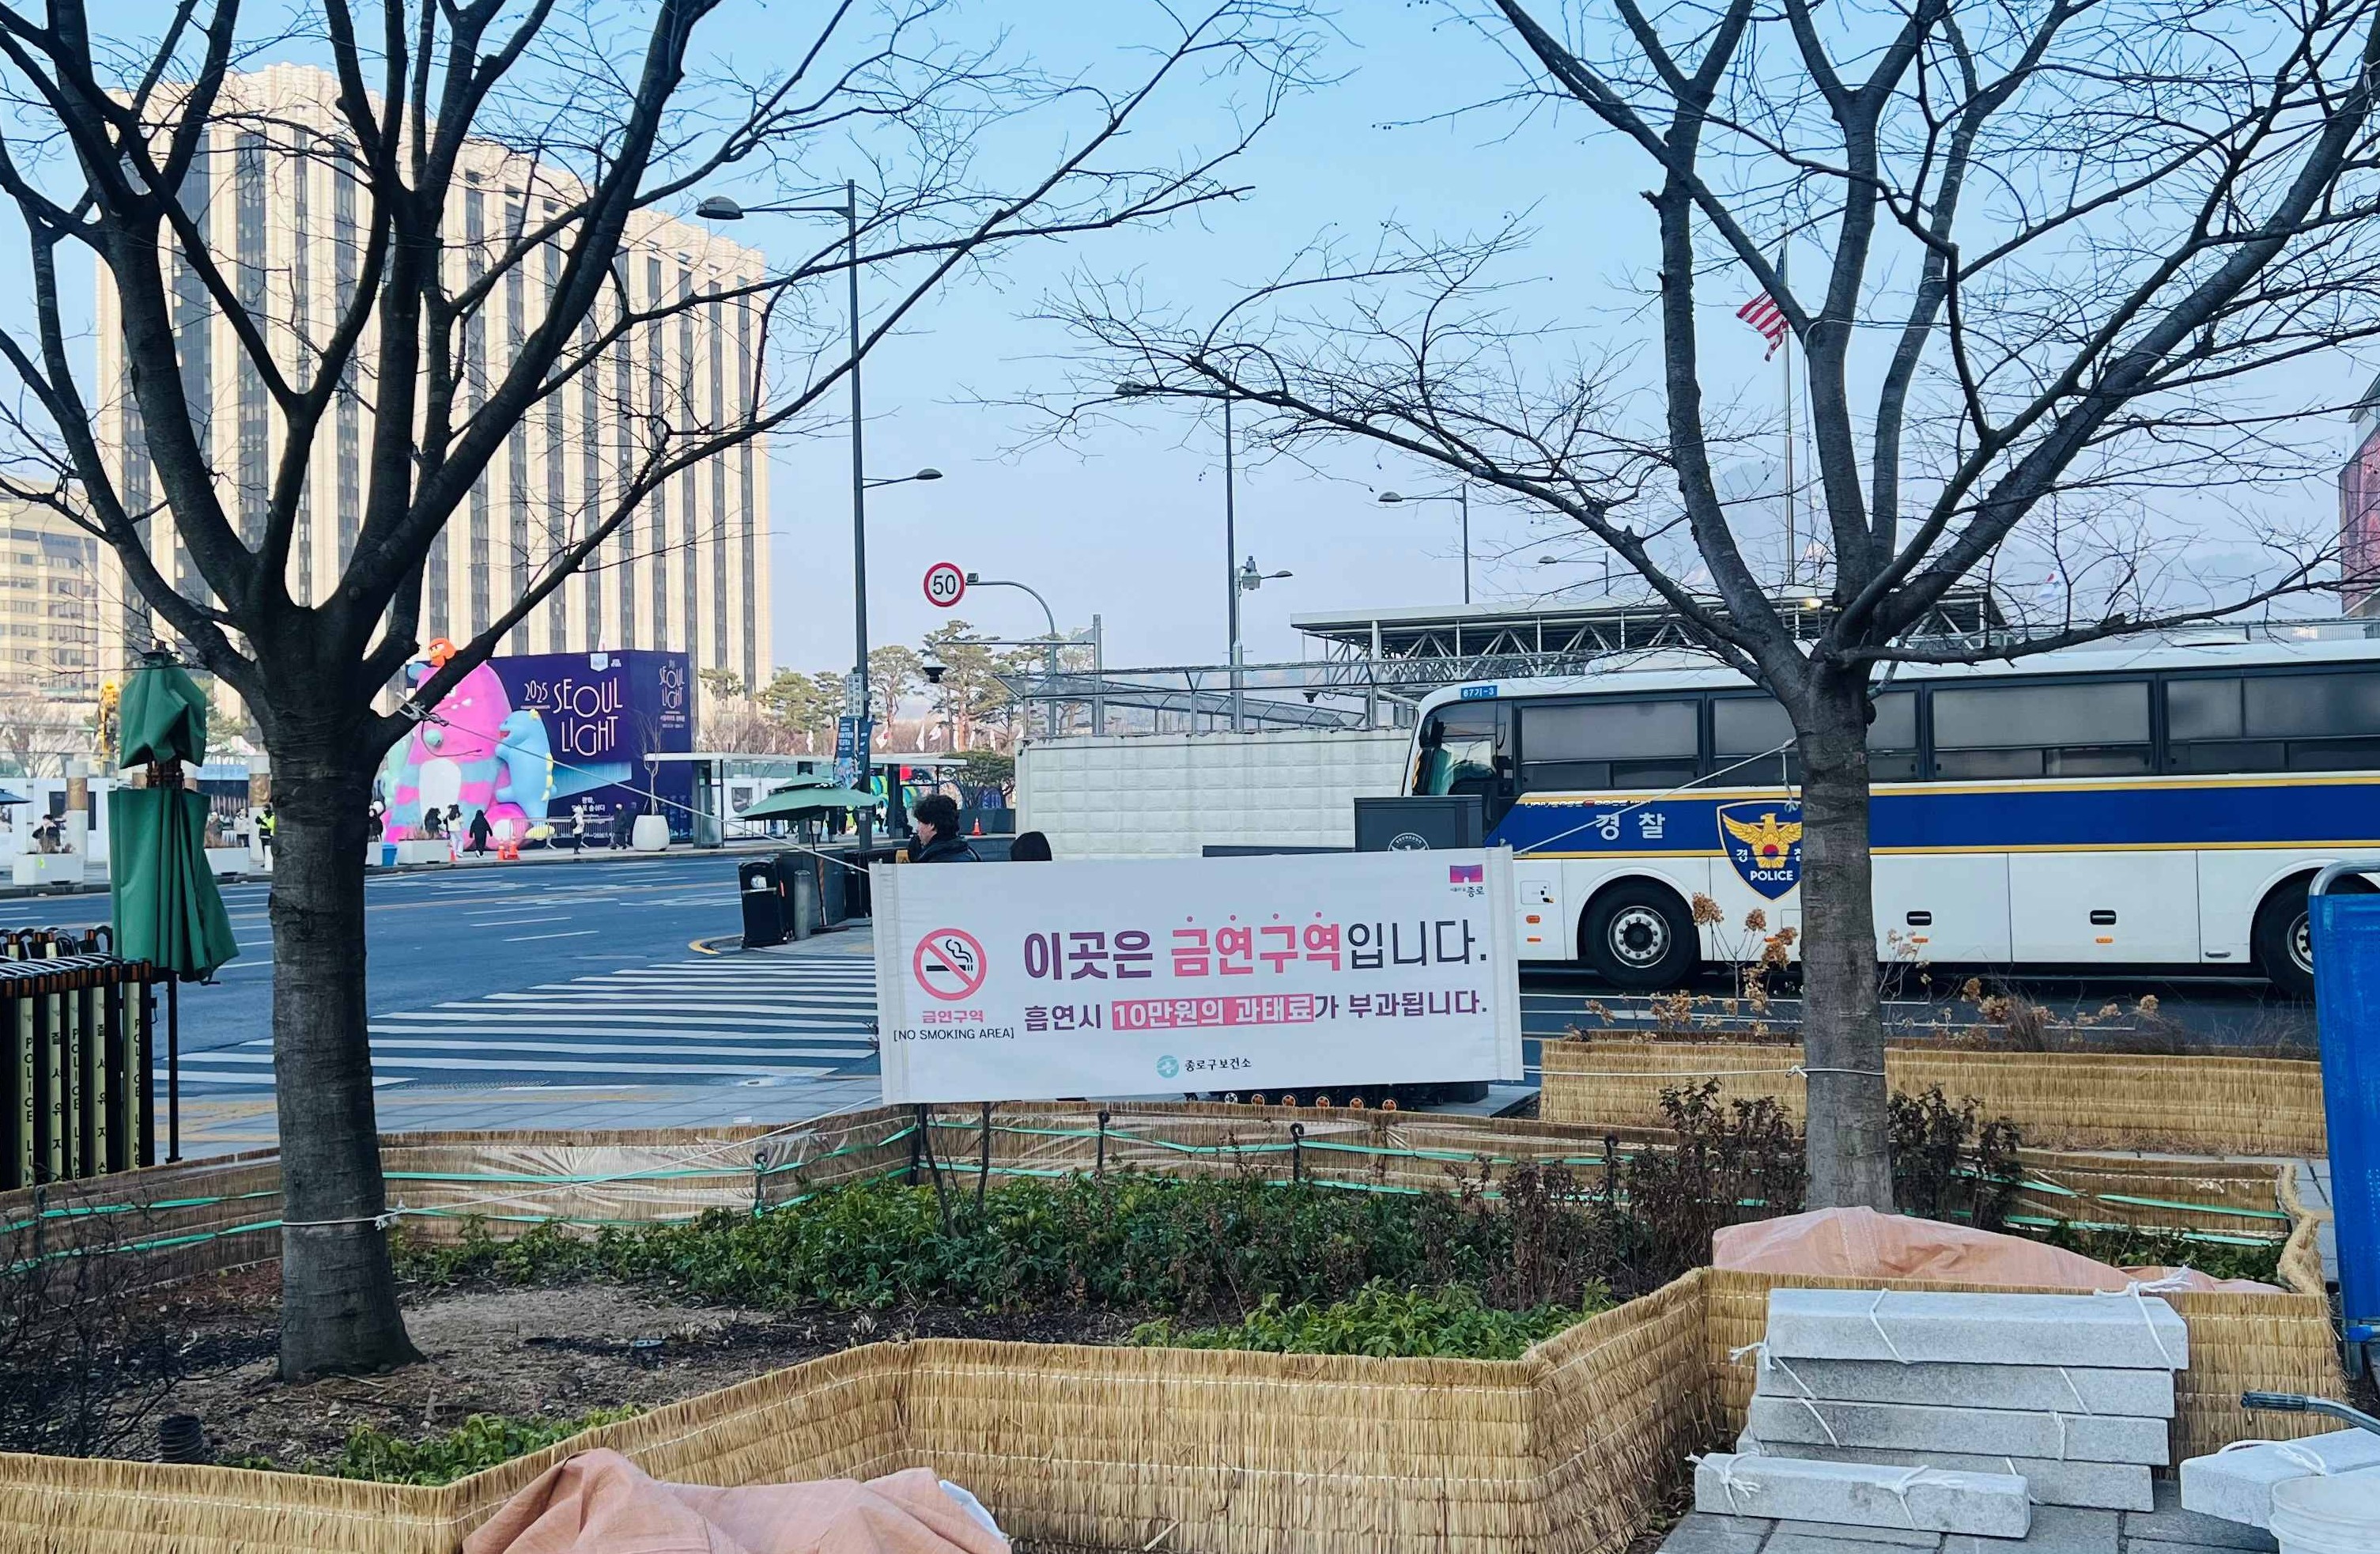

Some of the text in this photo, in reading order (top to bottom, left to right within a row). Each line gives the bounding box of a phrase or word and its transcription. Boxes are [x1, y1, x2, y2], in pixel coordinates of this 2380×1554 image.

[933, 574, 956, 595] 50
[659, 665, 685, 689] SEOUL
[523, 677, 623, 718] 2025 SEOUL
[661, 686, 683, 709] LIGHT
[561, 716, 619, 757] LIGHT
[1750, 870, 1793, 881] POLICE
[1024, 919, 1487, 981] 이곳은 금연구역입니다.
[922, 1009, 984, 1023] 금연구역
[1024, 989, 1487, 1032] 흡연시 10만원의 과태료가 부과됩니다.
[893, 1027, 1014, 1042] [NO SMOKING AREA]
[1185, 1057, 1252, 1072] 종로구보건소
[25, 1037, 33, 1122] POLICE
